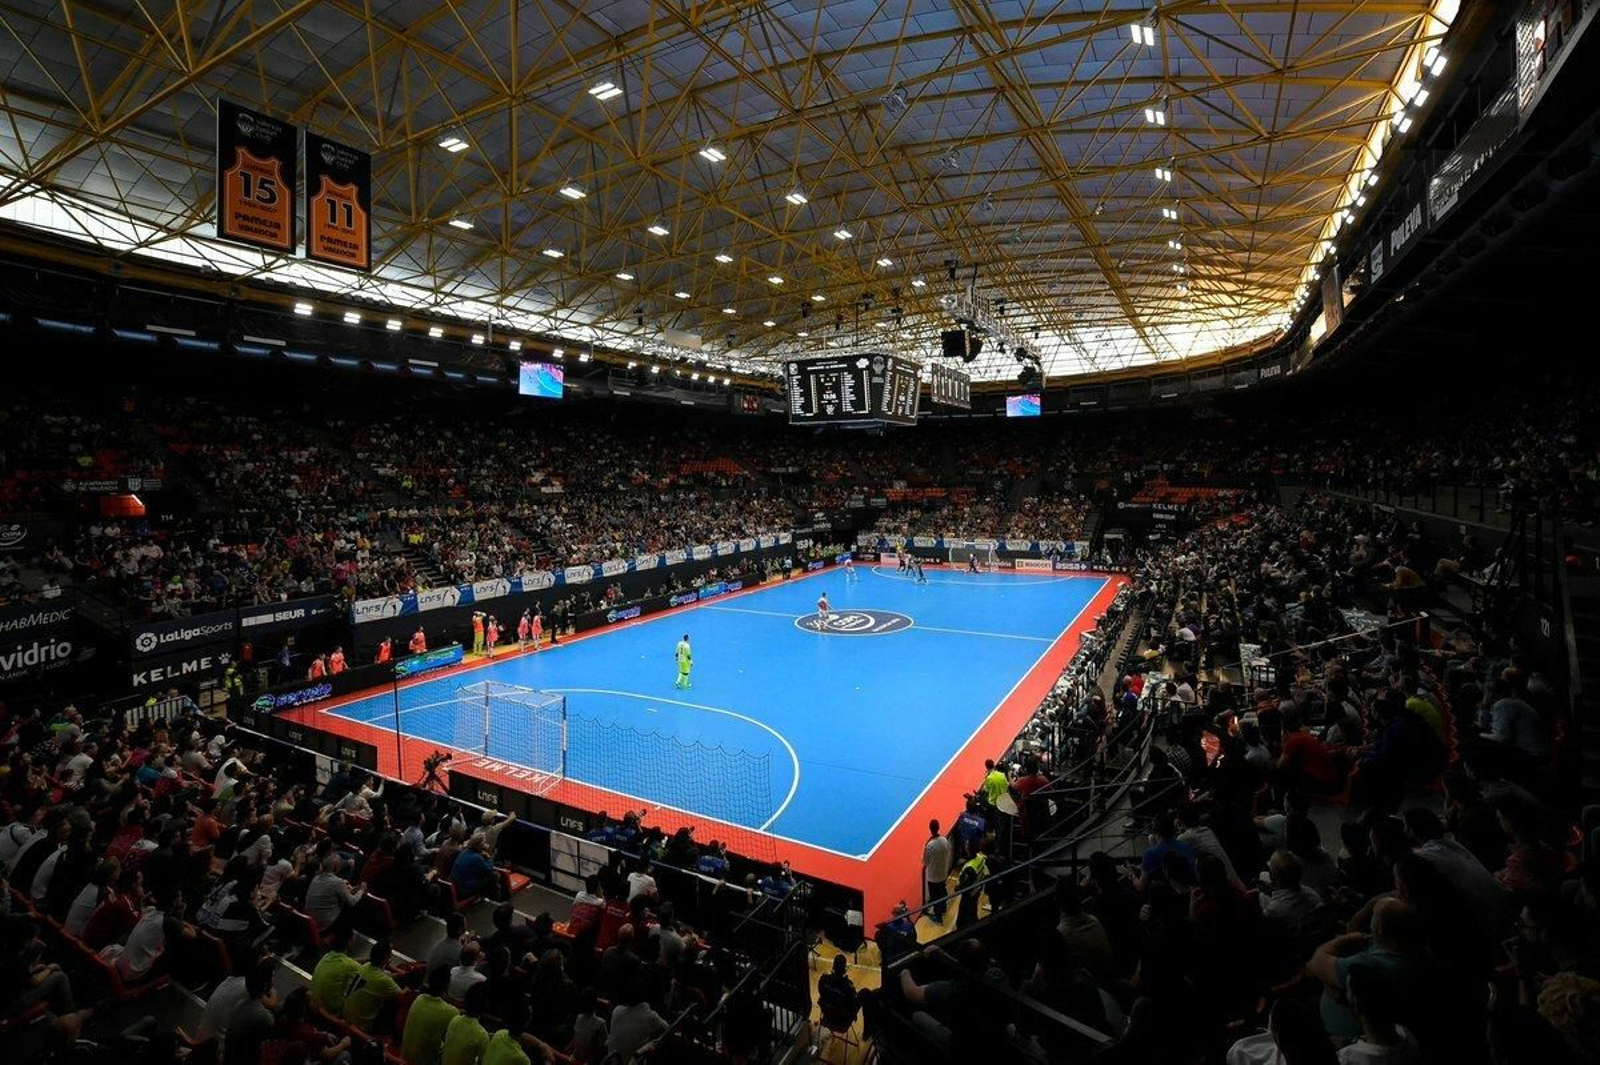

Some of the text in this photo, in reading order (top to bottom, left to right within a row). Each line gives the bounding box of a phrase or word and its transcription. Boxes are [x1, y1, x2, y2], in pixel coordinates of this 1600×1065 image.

[239, 170, 278, 205] 15
[325, 197, 354, 230] 11
[1391, 202, 1422, 256] PULEVA
[0, 606, 75, 632] HABMEDIC
[275, 608, 305, 622] SEUR
[160, 621, 233, 643] LaLigaSports
[0, 638, 72, 671] vidrio
[132, 656, 213, 687] KELME
[472, 758, 548, 783] KELME
[477, 789, 498, 805] LNFS
[560, 816, 584, 832] LNFS
